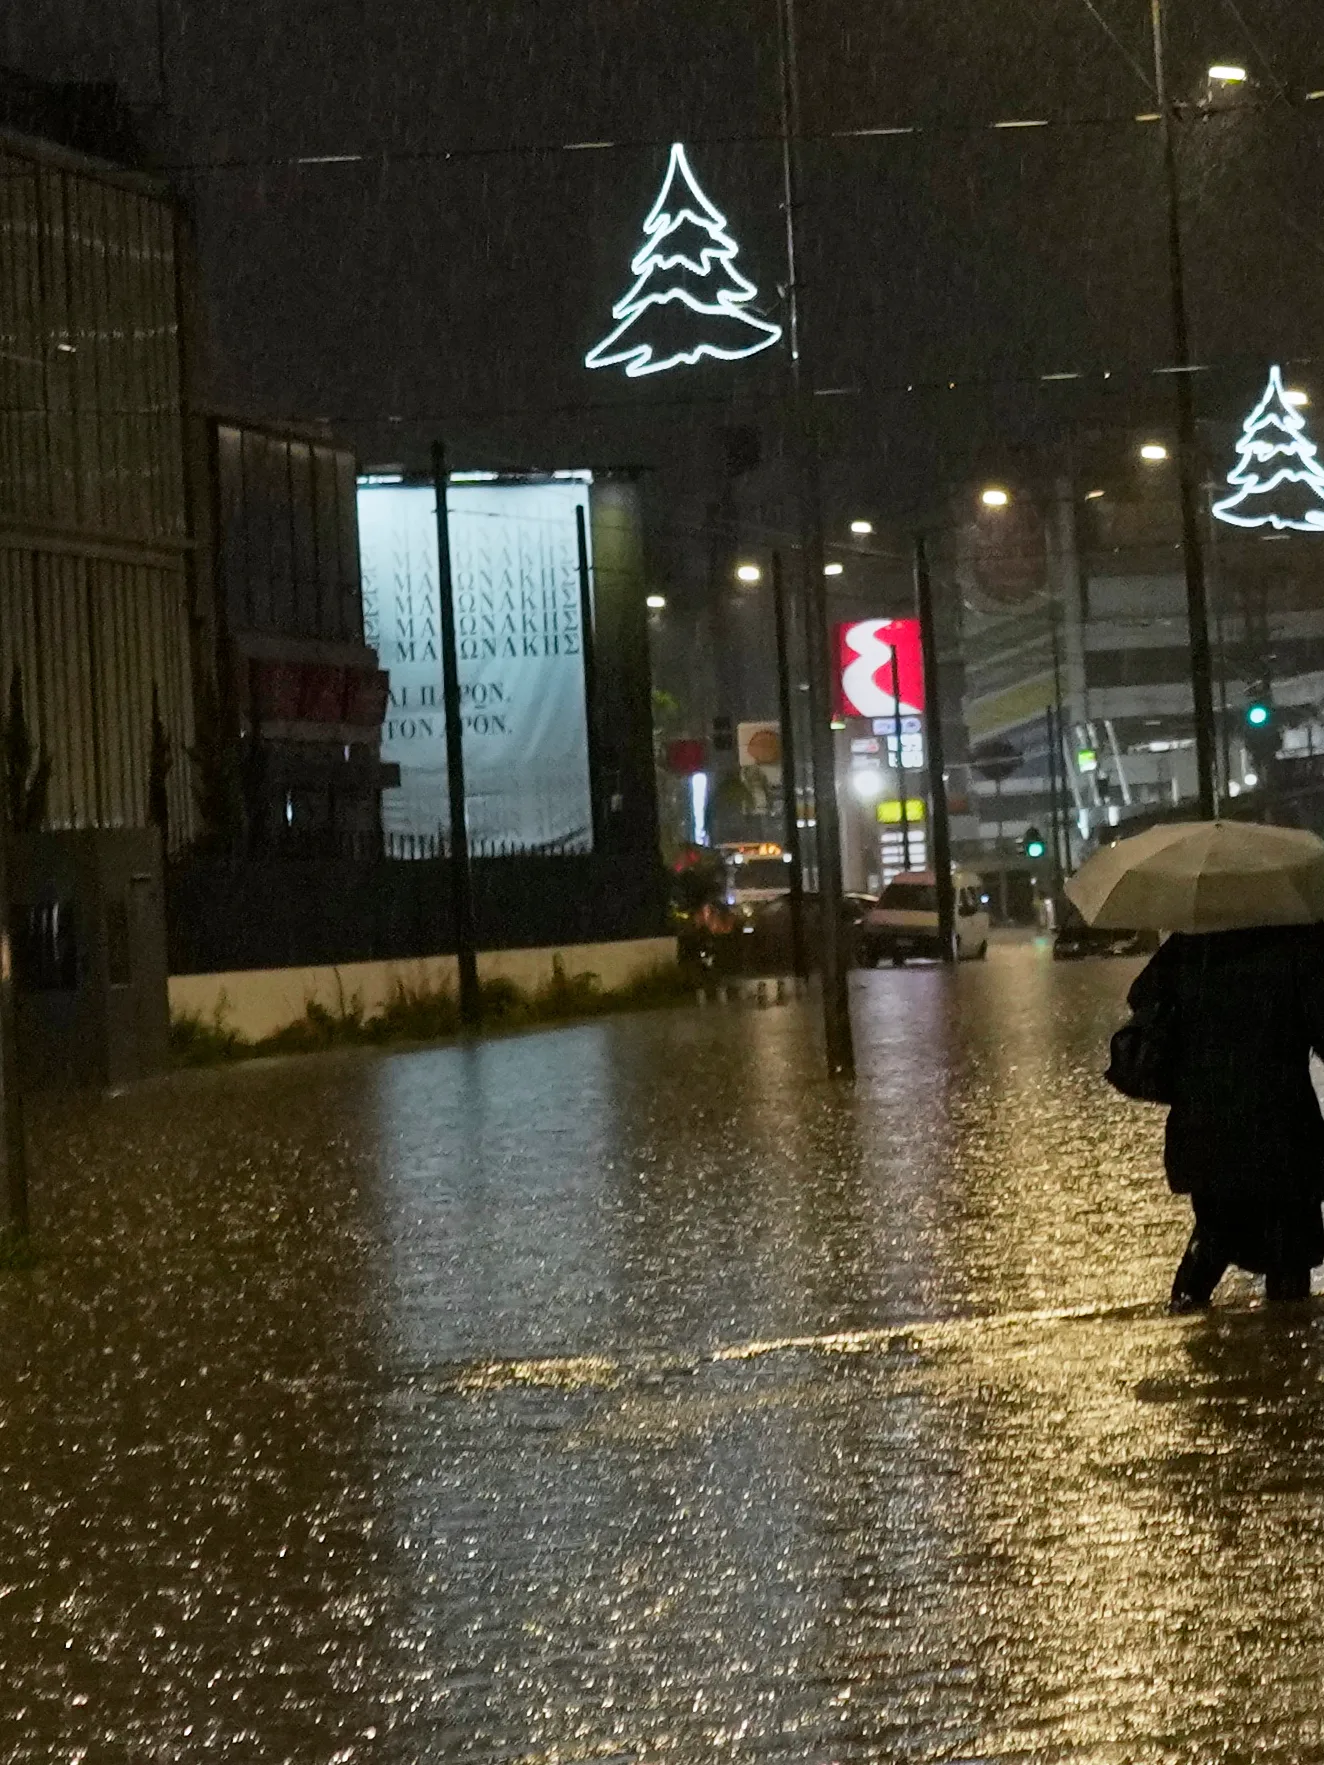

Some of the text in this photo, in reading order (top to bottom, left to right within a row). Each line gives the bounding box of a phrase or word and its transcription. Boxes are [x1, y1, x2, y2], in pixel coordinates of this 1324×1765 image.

[394, 568, 576, 593] ΜΑΩΝΑΚΗΣ
[395, 589, 577, 616] ΜΑΩΝΑΚΗΣ
[396, 612, 578, 638] ΜΑΩΝΑΚΗΣ
[397, 634, 579, 662] ΜΑΩΝΑΚΗΣ
